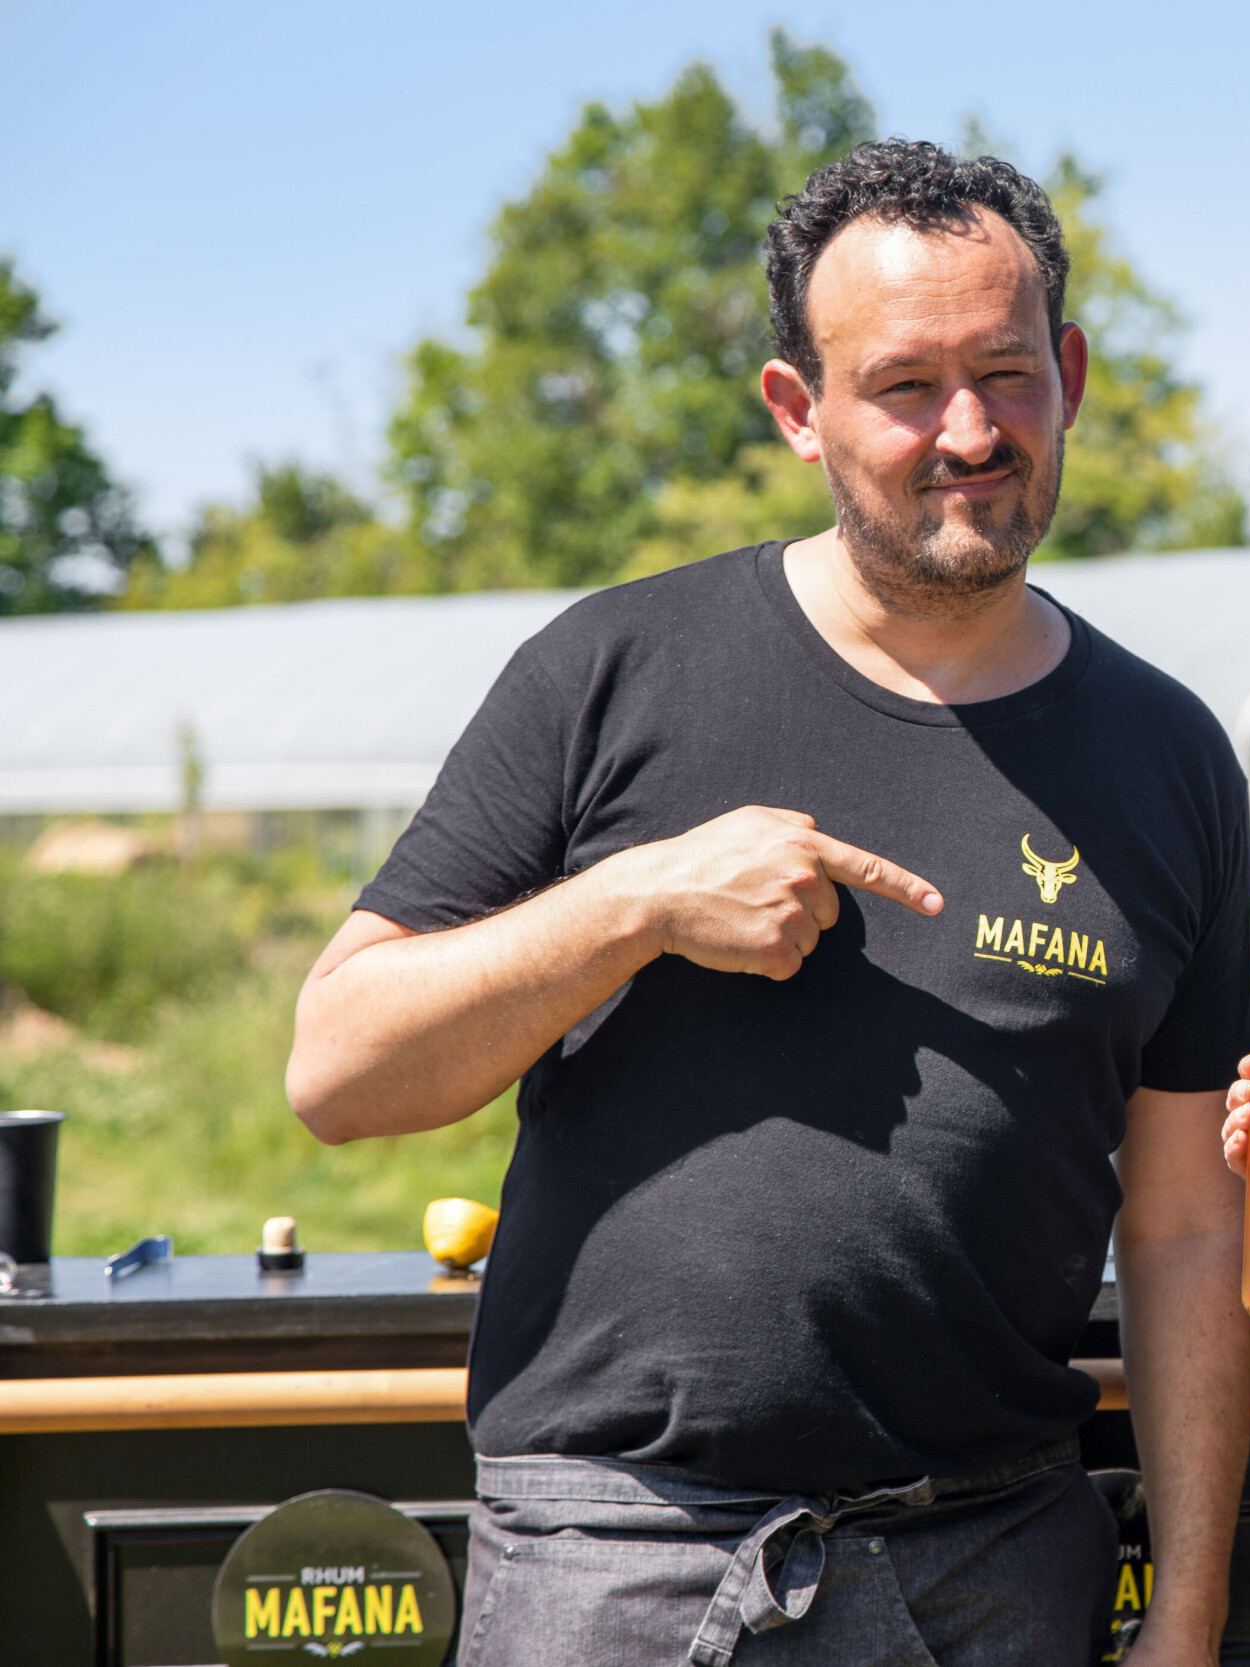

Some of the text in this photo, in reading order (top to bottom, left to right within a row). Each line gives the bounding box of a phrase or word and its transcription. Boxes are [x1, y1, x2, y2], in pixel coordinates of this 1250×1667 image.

[975, 914, 1108, 976] MAFANA
[300, 1565, 366, 1586] RHUM
[245, 1583, 424, 1639] MAFANA
